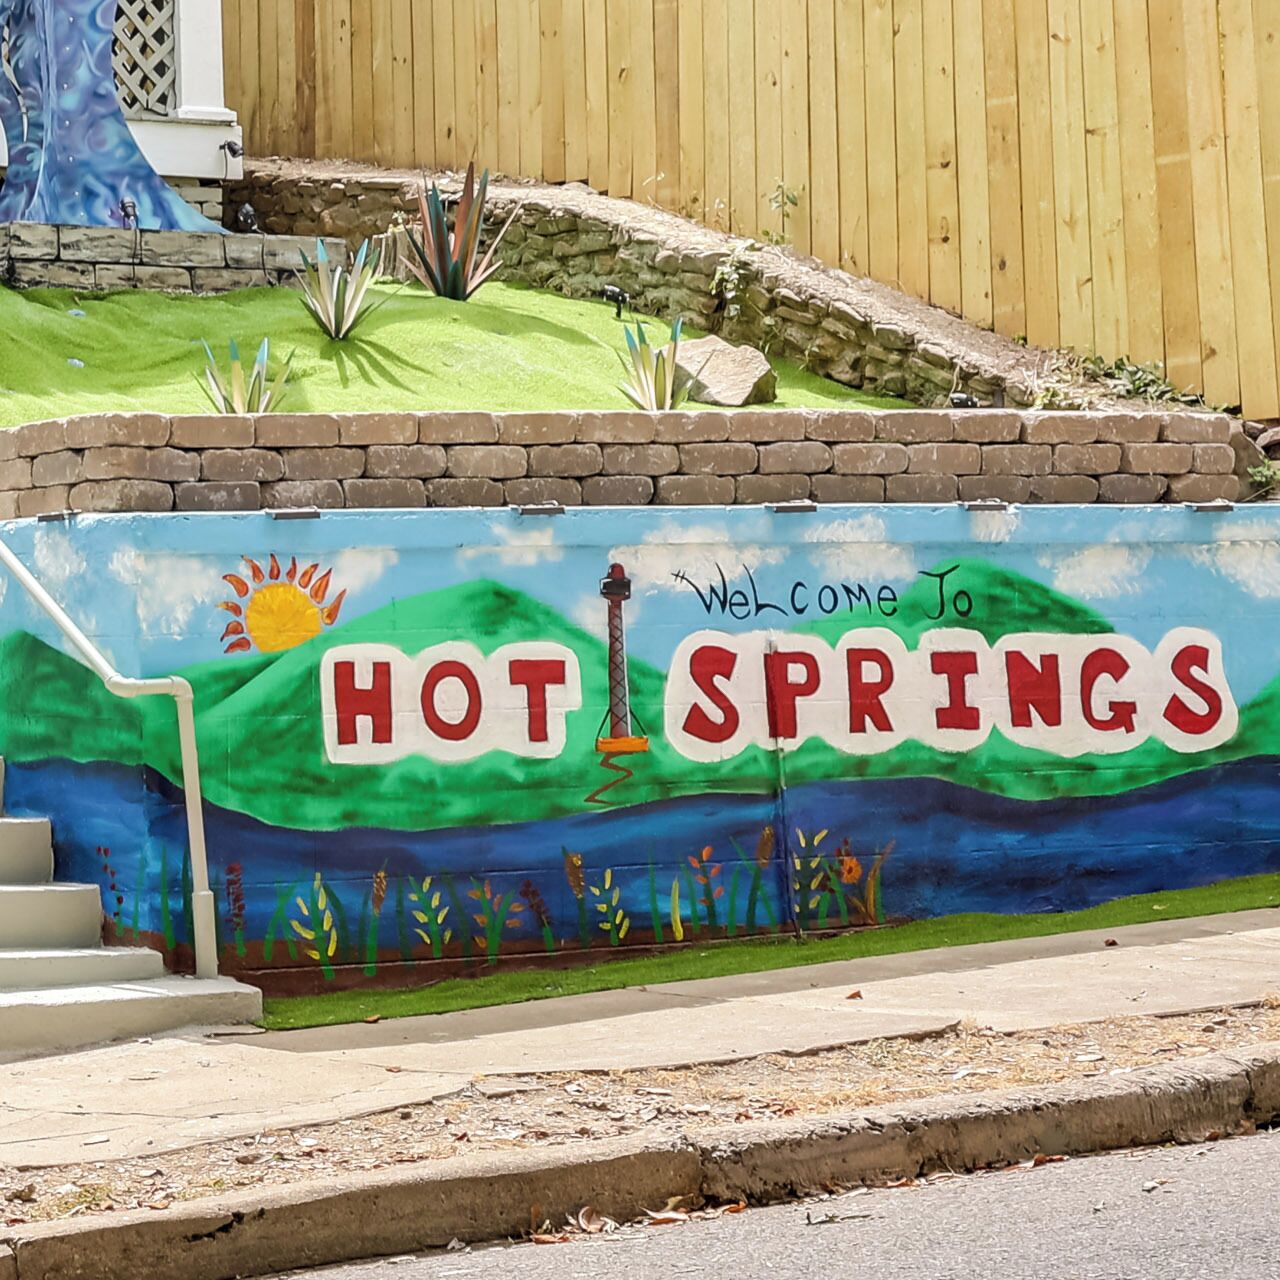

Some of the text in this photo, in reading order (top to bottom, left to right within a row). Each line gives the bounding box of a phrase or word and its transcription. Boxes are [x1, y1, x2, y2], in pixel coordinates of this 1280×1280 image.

[918, 564, 974, 620] To
[333, 643, 1224, 746] HOT SPRINGS
